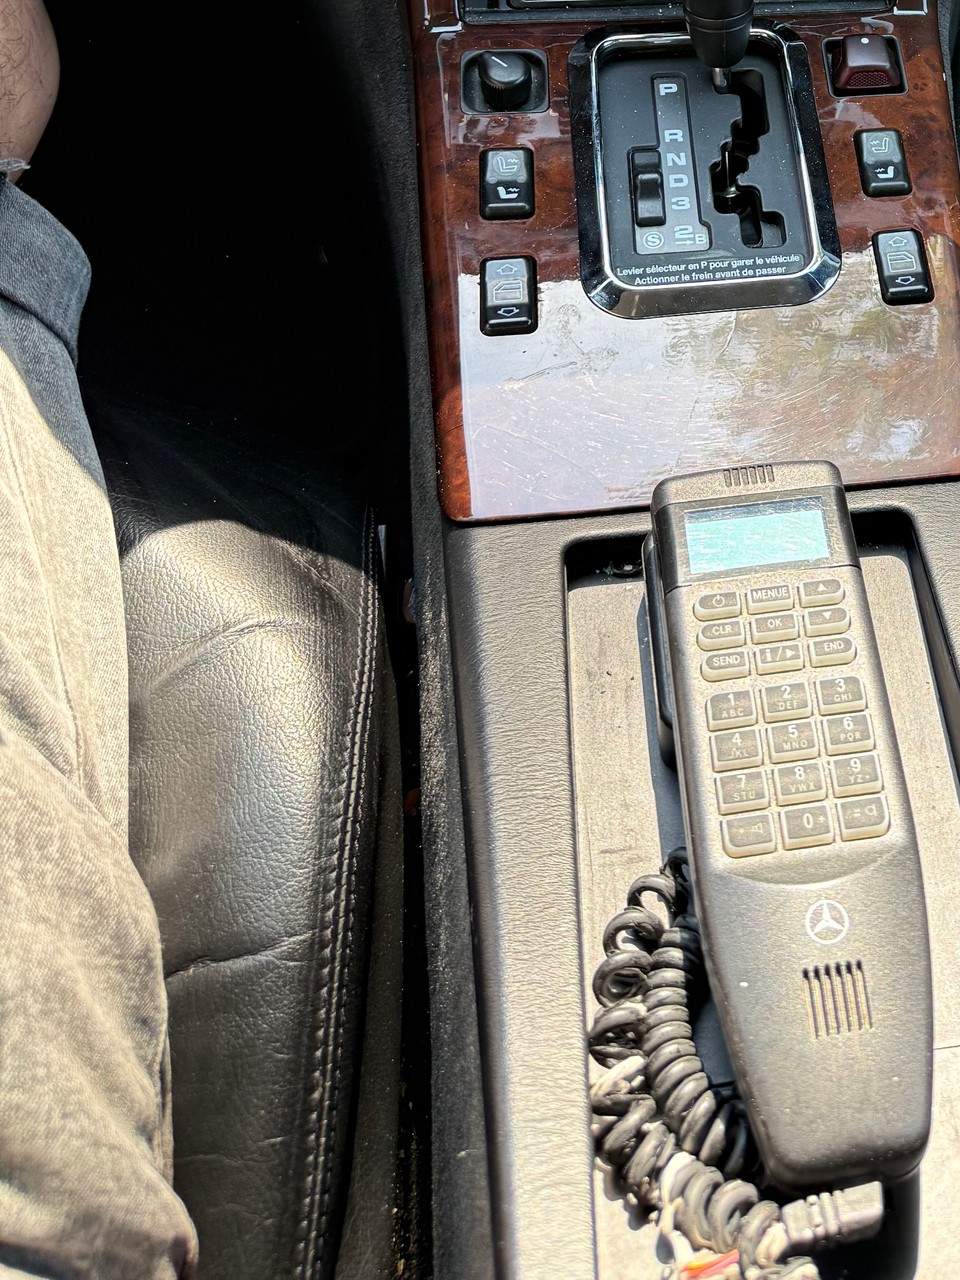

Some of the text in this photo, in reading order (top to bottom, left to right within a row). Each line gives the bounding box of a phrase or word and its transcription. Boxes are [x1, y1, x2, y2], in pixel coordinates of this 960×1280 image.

[660, 84, 678, 96] P
[664, 130, 684, 142] R
[666, 152, 686, 166] N
[670, 174, 688, 188] D
[672, 197, 690, 210] 3
[674, 225, 694, 239] 2
[696, 234, 707, 245] B
[618, 267, 644, 276] Levier
[646, 262, 686, 274] sélecteur
[701, 260, 707, 269] P
[710, 260, 730, 270] pour
[731, 258, 754, 268] garer
[756, 256, 764, 264] le
[765, 254, 800, 264] véhicule
[634, 266, 786, 286] Actionner le frein avant de passer
[752, 588, 788, 601] MENUE
[768, 619, 782, 628] OK
[712, 626, 732, 636] CLR
[824, 640, 844, 652] END
[713, 655, 740, 666] SEND
[836, 678, 846, 692] 3
[781, 686, 792, 699] 2
[834, 692, 852, 702] GHI
[728, 694, 735, 706] 1
[778, 701, 799, 710] DEF
[722, 708, 744, 718] ABC
[844, 716, 854, 730] 6
[788, 725, 798, 738] 5
[840, 732, 862, 742] PQR
[732, 732, 742, 746] 4
[783, 739, 808, 750] MNO
[850, 758, 860, 772] 9
[795, 766, 805, 780] 8
[737, 774, 747, 788] 7
[790, 781, 815, 792] VWX
[734, 791, 756, 802] STU
[803, 813, 814, 829] 0
